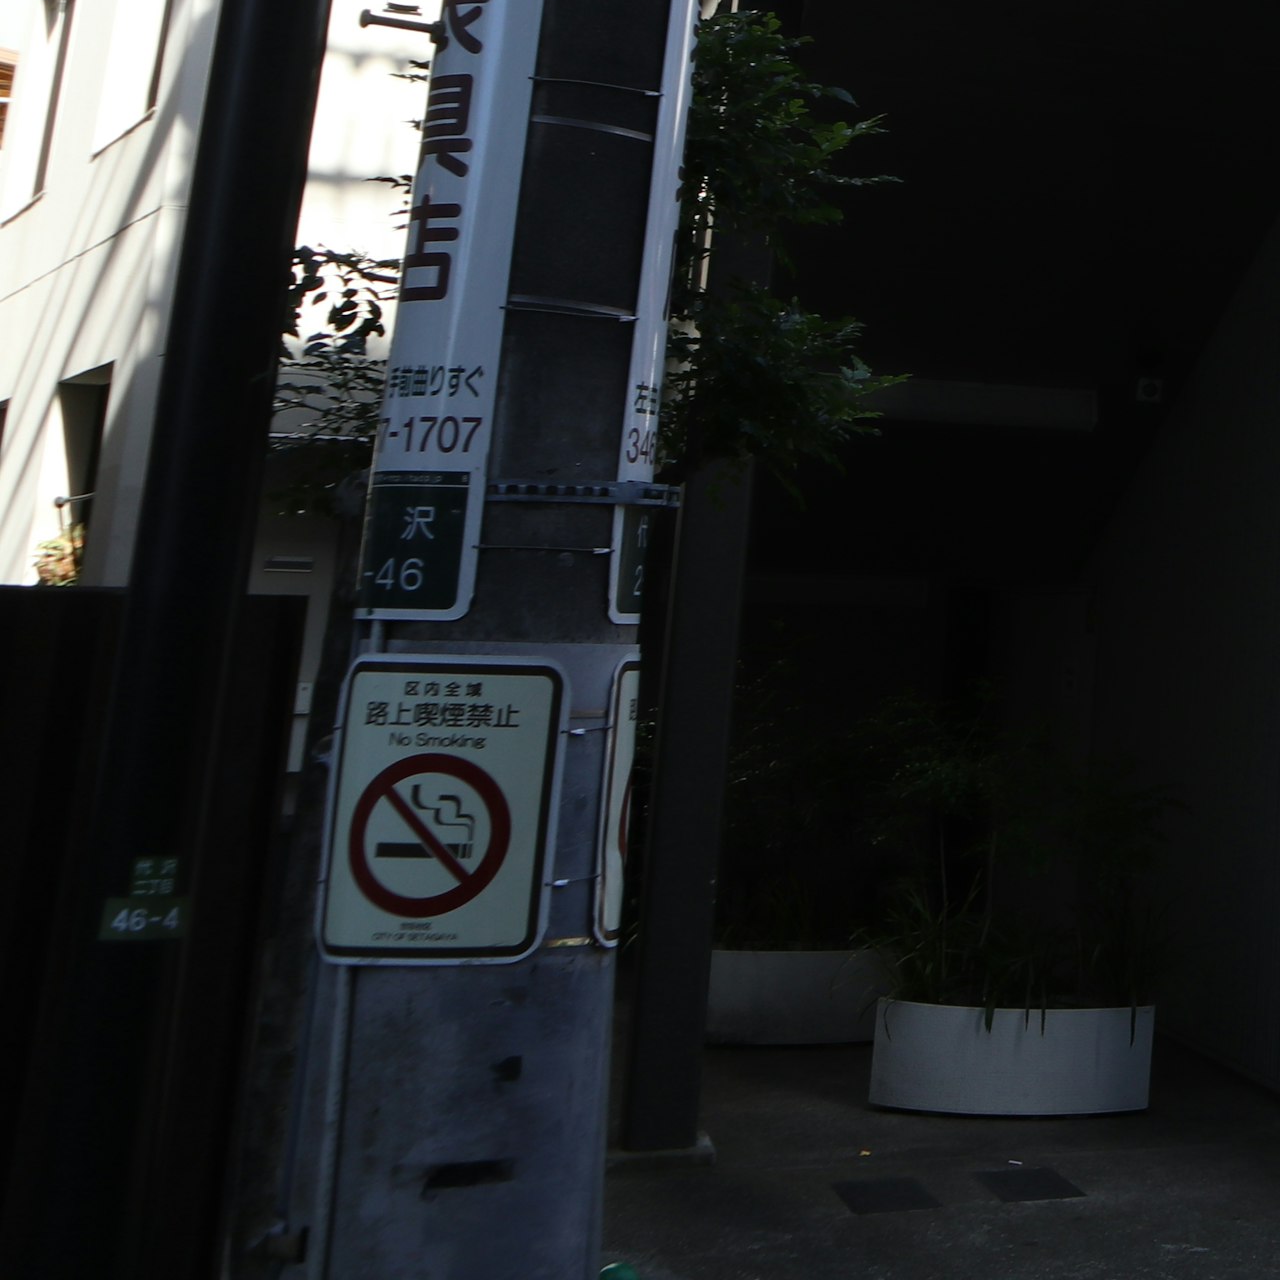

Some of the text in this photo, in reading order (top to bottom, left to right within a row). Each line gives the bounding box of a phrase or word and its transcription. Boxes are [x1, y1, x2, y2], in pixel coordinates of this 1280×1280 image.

[404, 681, 484, 697] 区内全域
[364, 701, 521, 729] 路上喫煙禁止
[388, 731, 487, 750] No Smoking
[110, 906, 179, 931] 46-4
